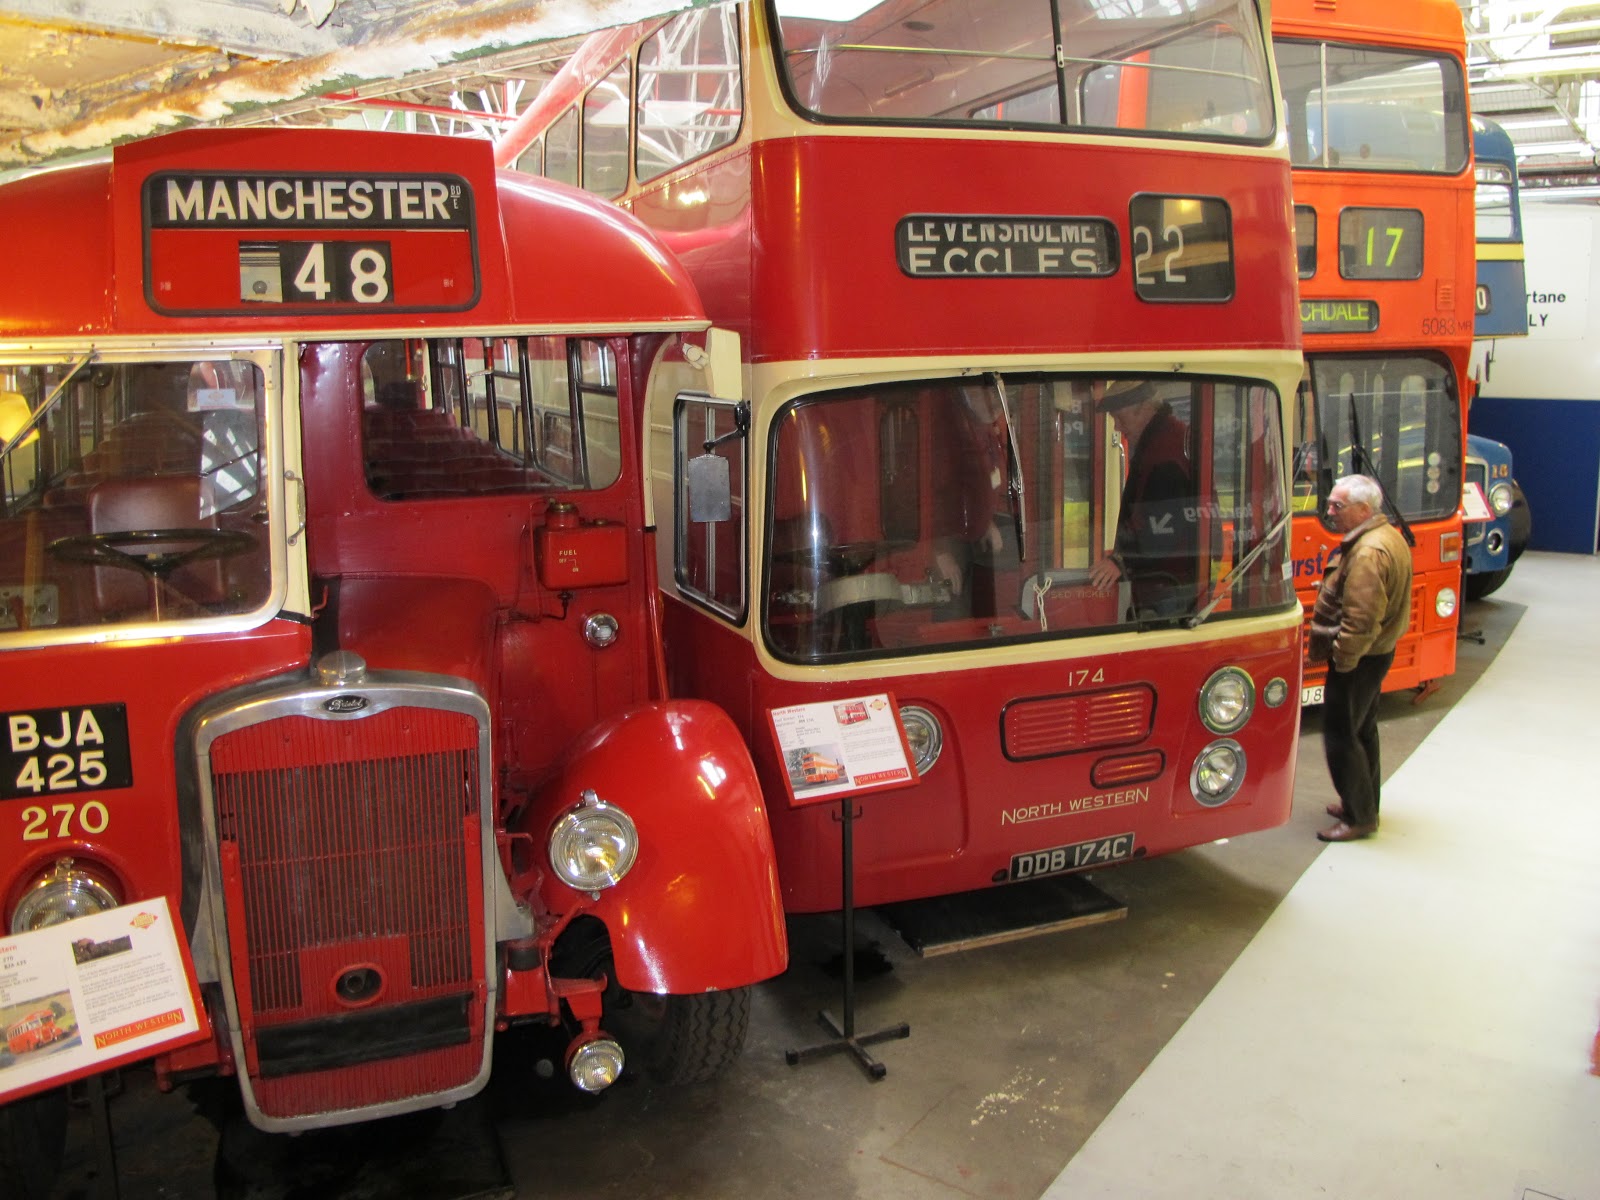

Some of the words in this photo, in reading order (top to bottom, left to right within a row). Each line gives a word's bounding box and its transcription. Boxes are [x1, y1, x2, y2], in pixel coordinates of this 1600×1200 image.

[166, 180, 451, 222] MANCHESTER
[907, 222, 1096, 243] LEVENSHULME
[1366, 227, 1404, 266] 17
[1133, 226, 1187, 285] 22
[1422, 317, 1455, 335] 5083
[1068, 667, 1105, 687] 174
[8, 709, 105, 753] BJA
[16, 750, 108, 793] 425
[21, 801, 110, 842] 270
[1001, 801, 1063, 826] NORTH
[1069, 786, 1150, 811] WESTERN
[1016, 850, 1067, 878] DDB
[1073, 837, 1128, 867] 174C
[95, 1026, 133, 1049] NORTH
[135, 1009, 183, 1032] WESTERN
